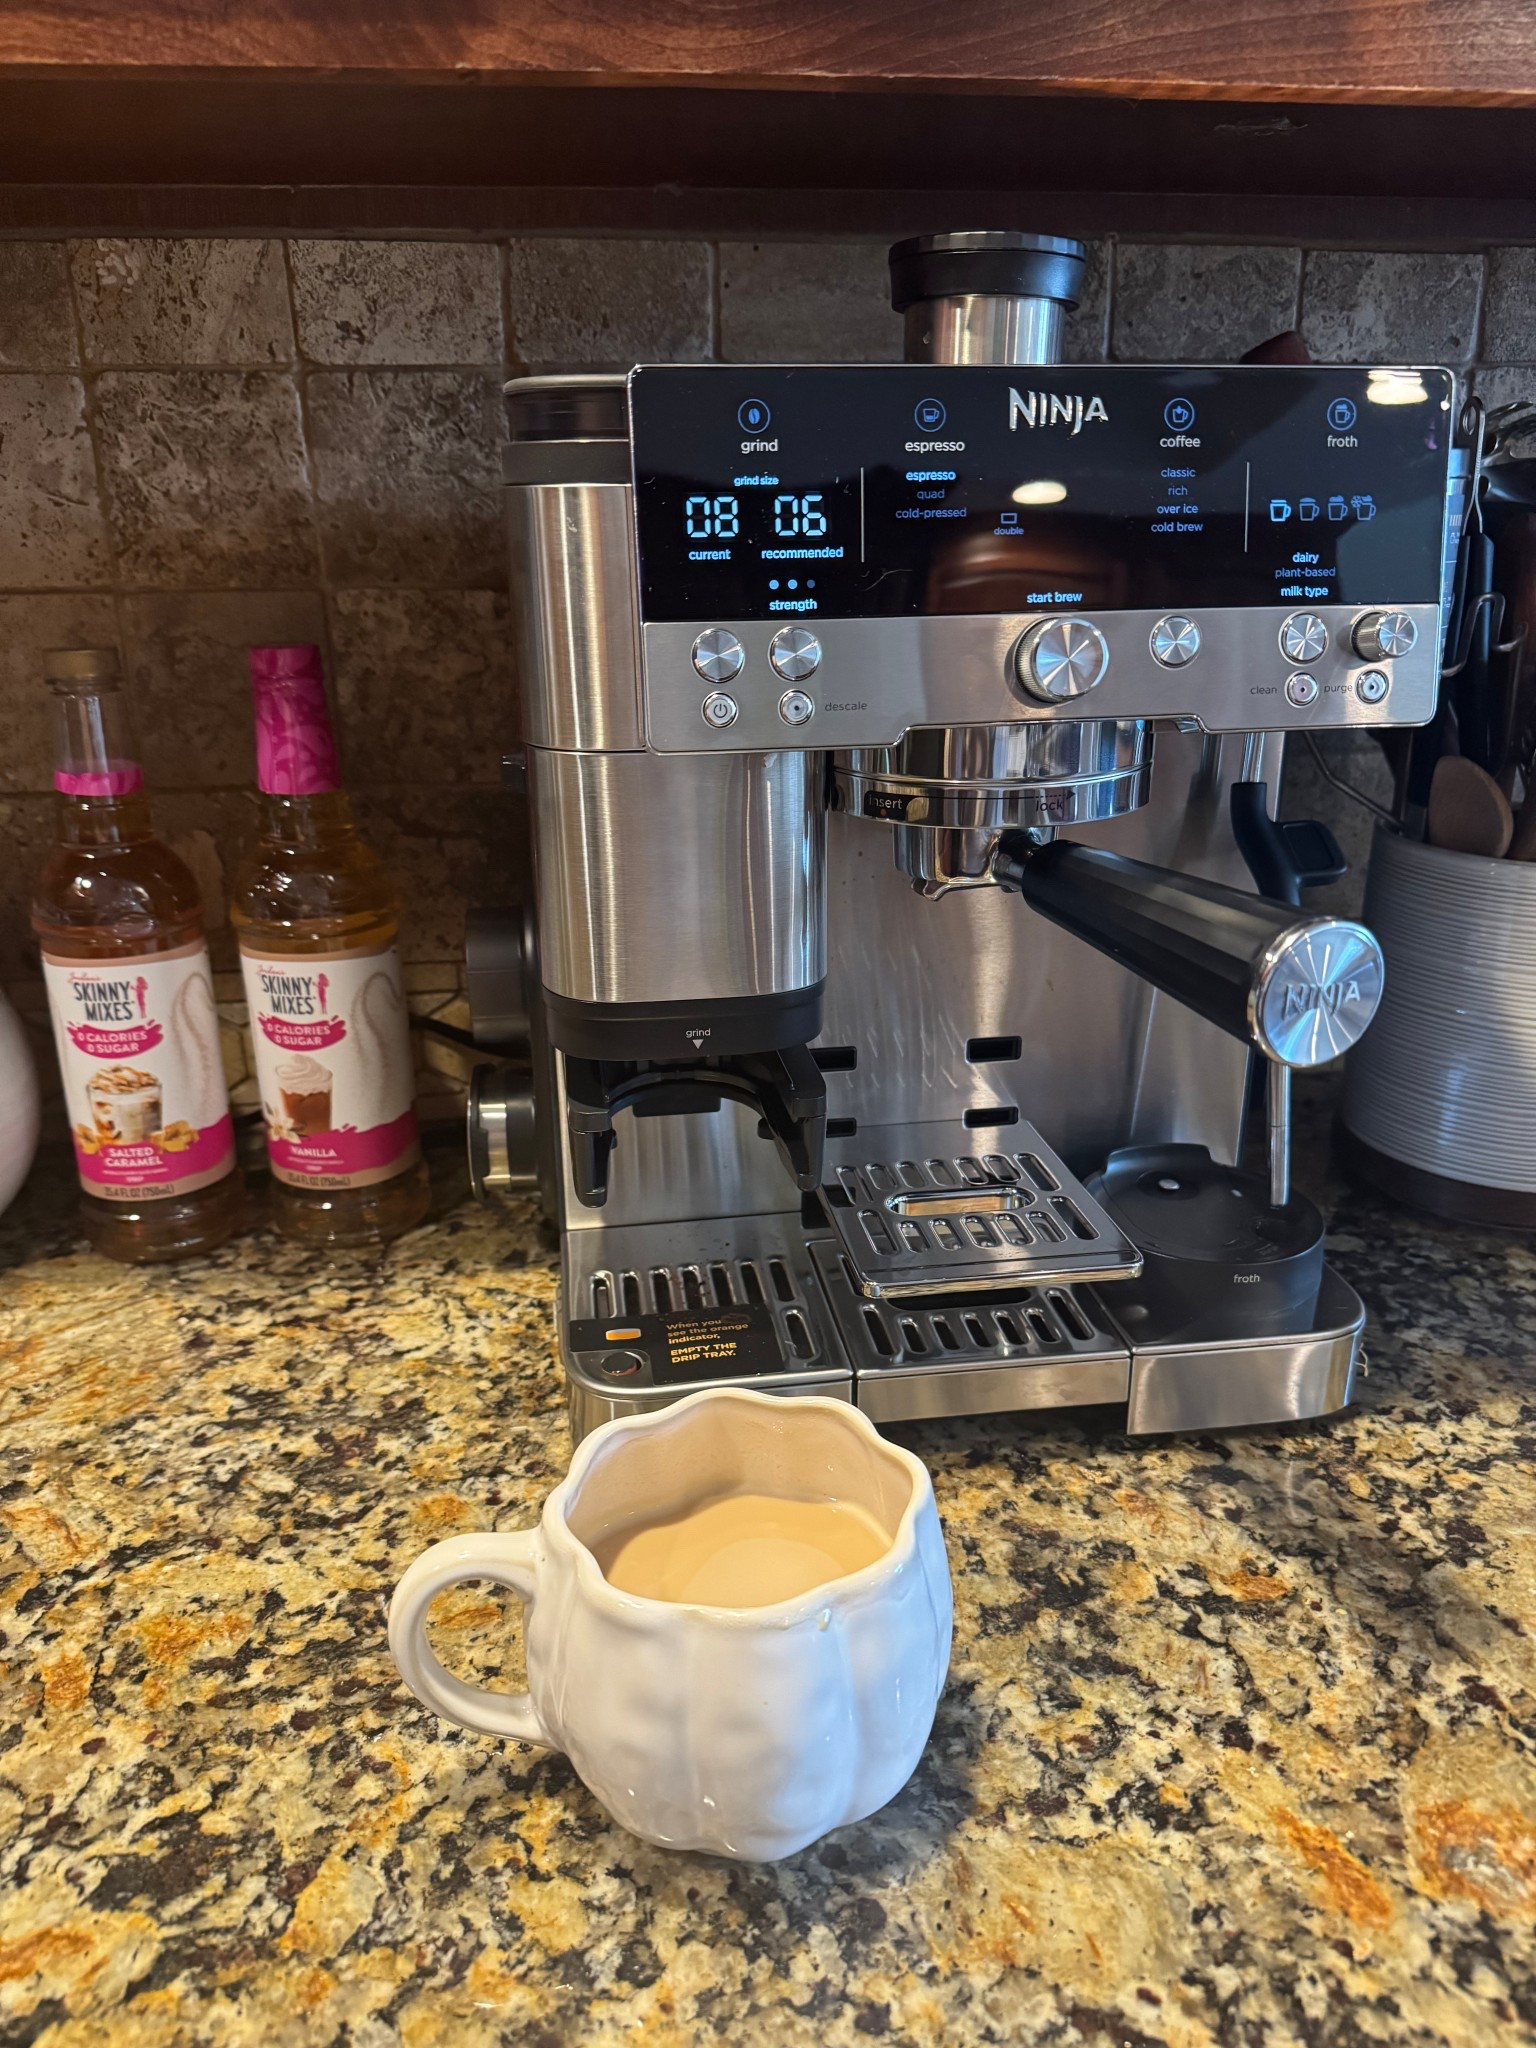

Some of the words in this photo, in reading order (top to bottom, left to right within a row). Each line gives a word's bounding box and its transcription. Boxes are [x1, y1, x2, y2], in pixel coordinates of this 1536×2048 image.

[1008, 387, 1109, 436] NINJA
[740, 438, 779, 454] grind
[904, 440, 965, 453] espresso
[1159, 435, 1201, 448] coffee
[1327, 435, 1358, 448] froth
[905, 470, 957, 482] espresso
[1160, 467, 1196, 478] classic
[733, 475, 759, 487] grind
[760, 476, 780, 486] size
[916, 488, 945, 500] quad
[1167, 485, 1188, 496] rich
[895, 507, 967, 519] cold-pressed
[1156, 504, 1180, 514] over
[1182, 503, 1199, 514] ice
[685, 496, 739, 538] 08
[774, 495, 827, 536] 06
[993, 526, 1025, 536] double
[1150, 522, 1174, 532] cold
[1176, 521, 1204, 532] brew
[688, 549, 732, 561] current
[761, 546, 844, 559] recommended
[1292, 552, 1320, 564] dairy
[1275, 566, 1336, 578] plant-based
[1026, 593, 1053, 603] start
[1054, 592, 1083, 603] brew
[1280, 586, 1303, 597] milk
[1304, 587, 1329, 598] type
[769, 598, 818, 612] strength
[1249, 685, 1278, 696] clean
[1323, 683, 1354, 694] purge
[824, 700, 868, 713] descale
[1035, 798, 1065, 813] lock
[261, 974, 312, 997] SKINNY
[73, 981, 130, 1003] SKINNY
[271, 994, 315, 1015] MIXES
[1281, 979, 1361, 1021] NINJA
[84, 1001, 133, 1022] MIXES
[275, 1025, 331, 1035] CALORIES
[685, 1028, 711, 1038] grind
[86, 1031, 148, 1043] CALORIES
[283, 1036, 322, 1046] SUGAR
[97, 1043, 139, 1054] SUGAR
[108, 1147, 154, 1158] SALTED
[290, 1145, 337, 1158] VANILLA
[105, 1156, 164, 1167] CARAMEL
[1233, 1273, 1260, 1283] froth
[666, 1322, 699, 1330] When
[709, 1323, 749, 1332] orange
[670, 1345, 710, 1356] EMPTY
[712, 1342, 737, 1350] THE
[671, 1353, 700, 1364] DRIP
[702, 1349, 736, 1359] TRAY.
